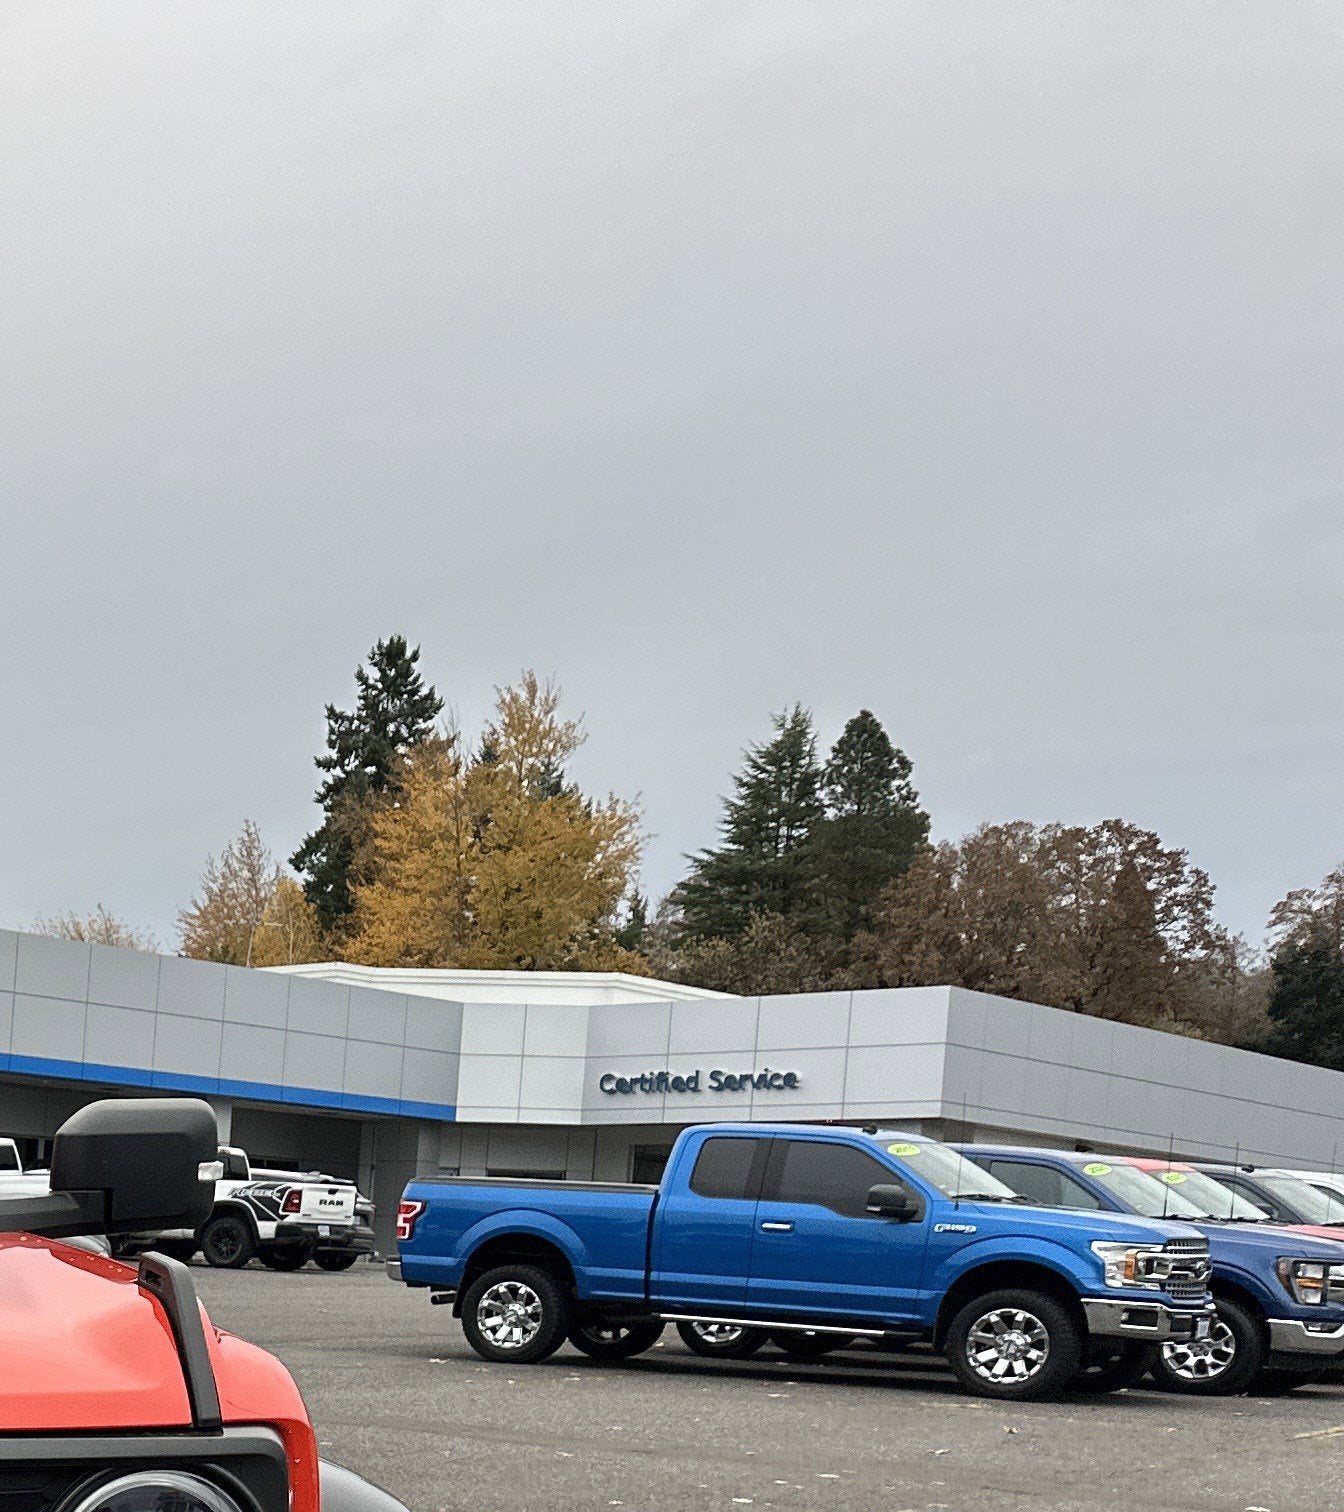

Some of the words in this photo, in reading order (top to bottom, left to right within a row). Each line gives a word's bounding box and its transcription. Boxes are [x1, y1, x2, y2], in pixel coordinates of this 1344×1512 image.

[599, 1070, 702, 1095] Certified
[709, 1067, 800, 1092] Service
[318, 1199, 344, 1207] RAM
